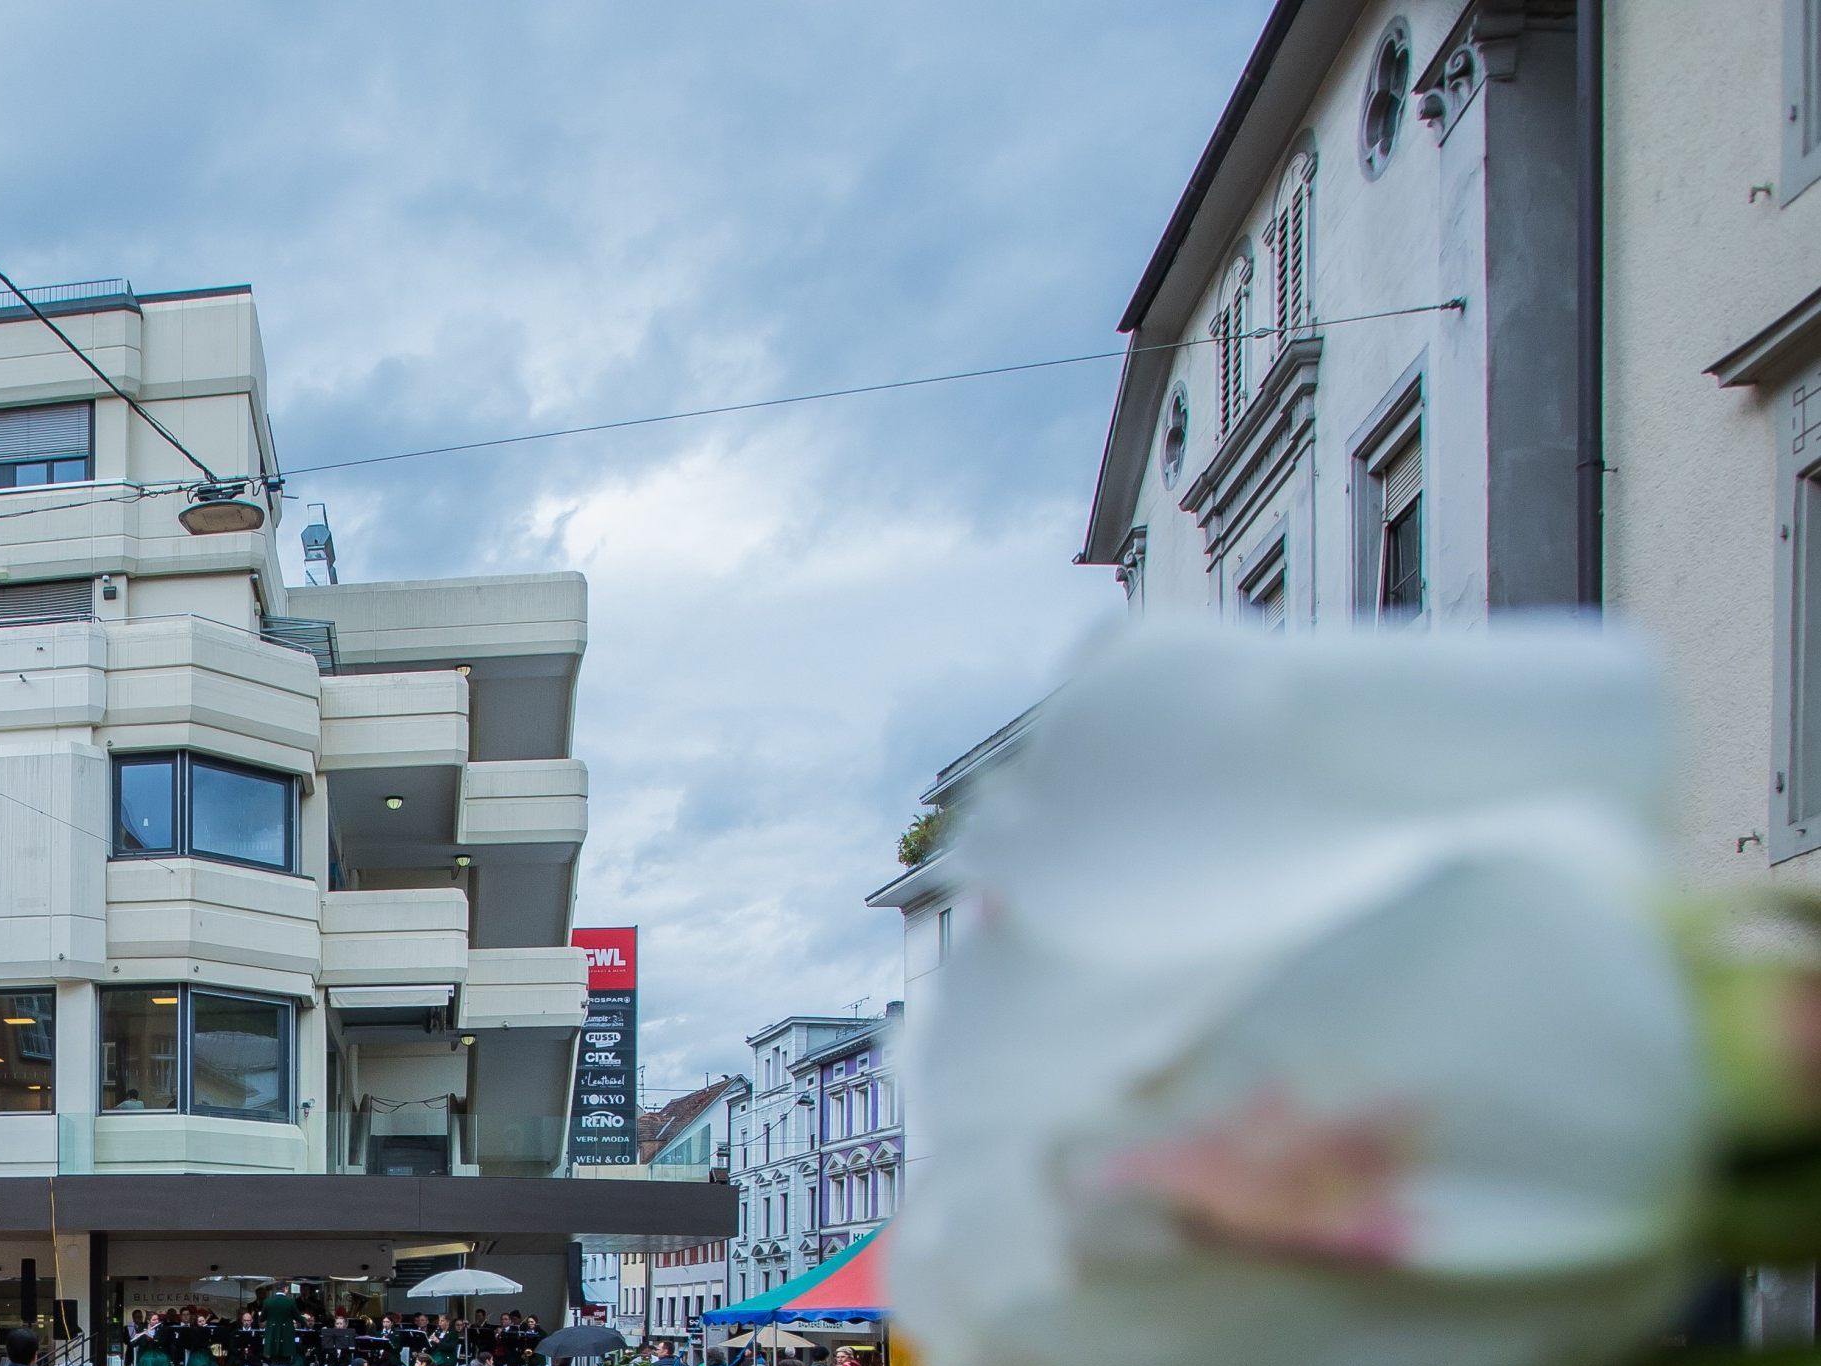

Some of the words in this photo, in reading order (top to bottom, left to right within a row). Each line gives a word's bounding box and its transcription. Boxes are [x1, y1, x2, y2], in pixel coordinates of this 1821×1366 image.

[588, 1033, 620, 1042] FUSSL
[585, 1052, 616, 1063] CITY
[581, 1094, 625, 1105] TOKYO
[581, 1115, 625, 1128] RENO
[604, 1155, 613, 1164] &
[614, 1155, 630, 1164] CO
